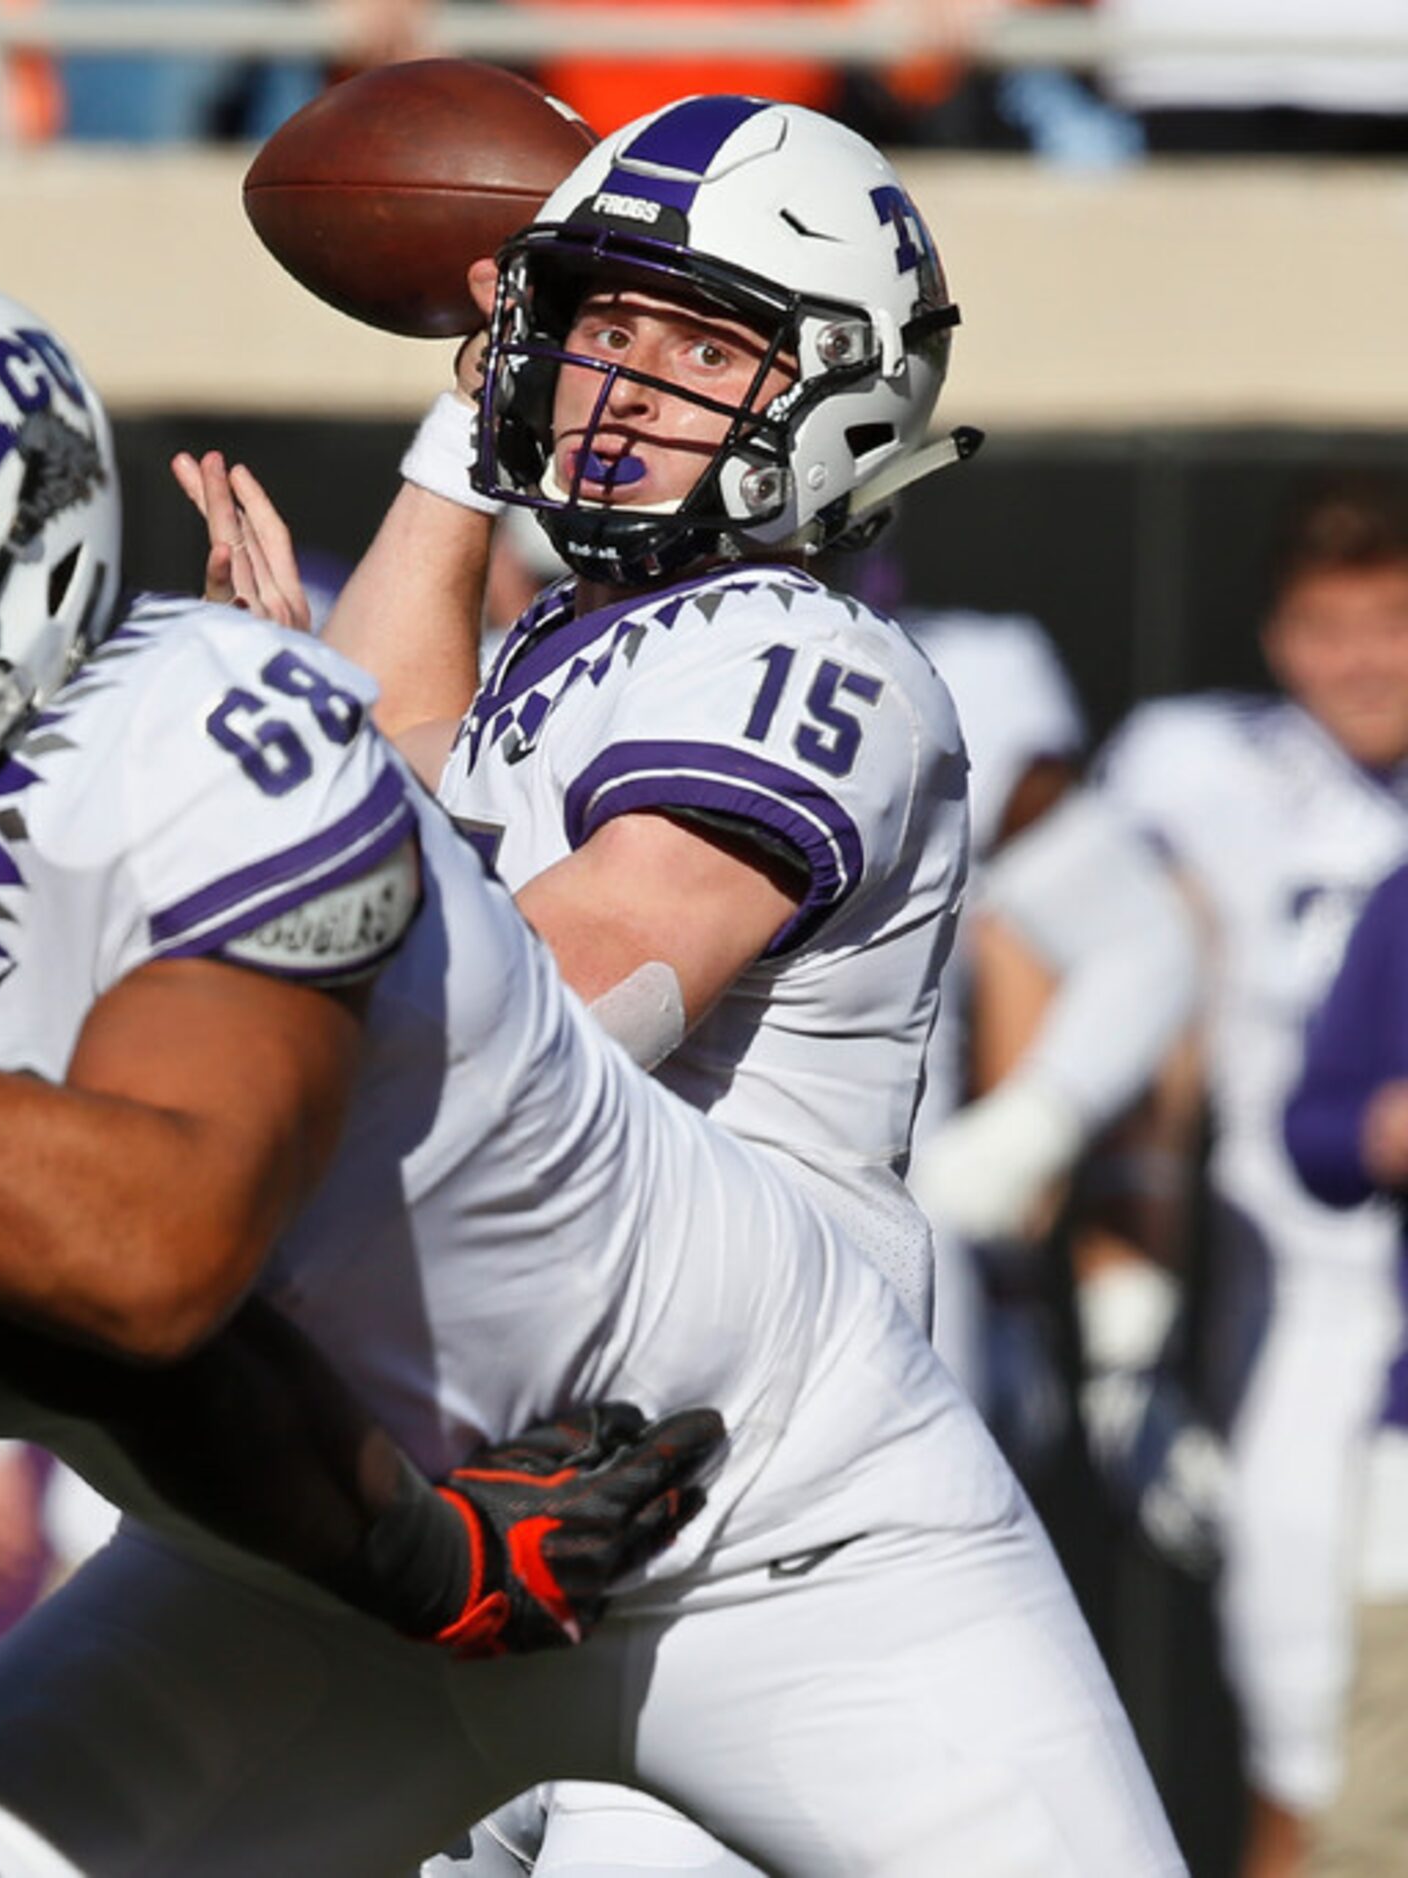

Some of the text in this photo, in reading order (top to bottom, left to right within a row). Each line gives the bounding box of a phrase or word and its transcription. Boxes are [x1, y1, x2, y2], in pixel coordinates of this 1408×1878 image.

[592, 191, 662, 224] FROGS
[206, 649, 363, 798] 68
[743, 643, 884, 778] 15
